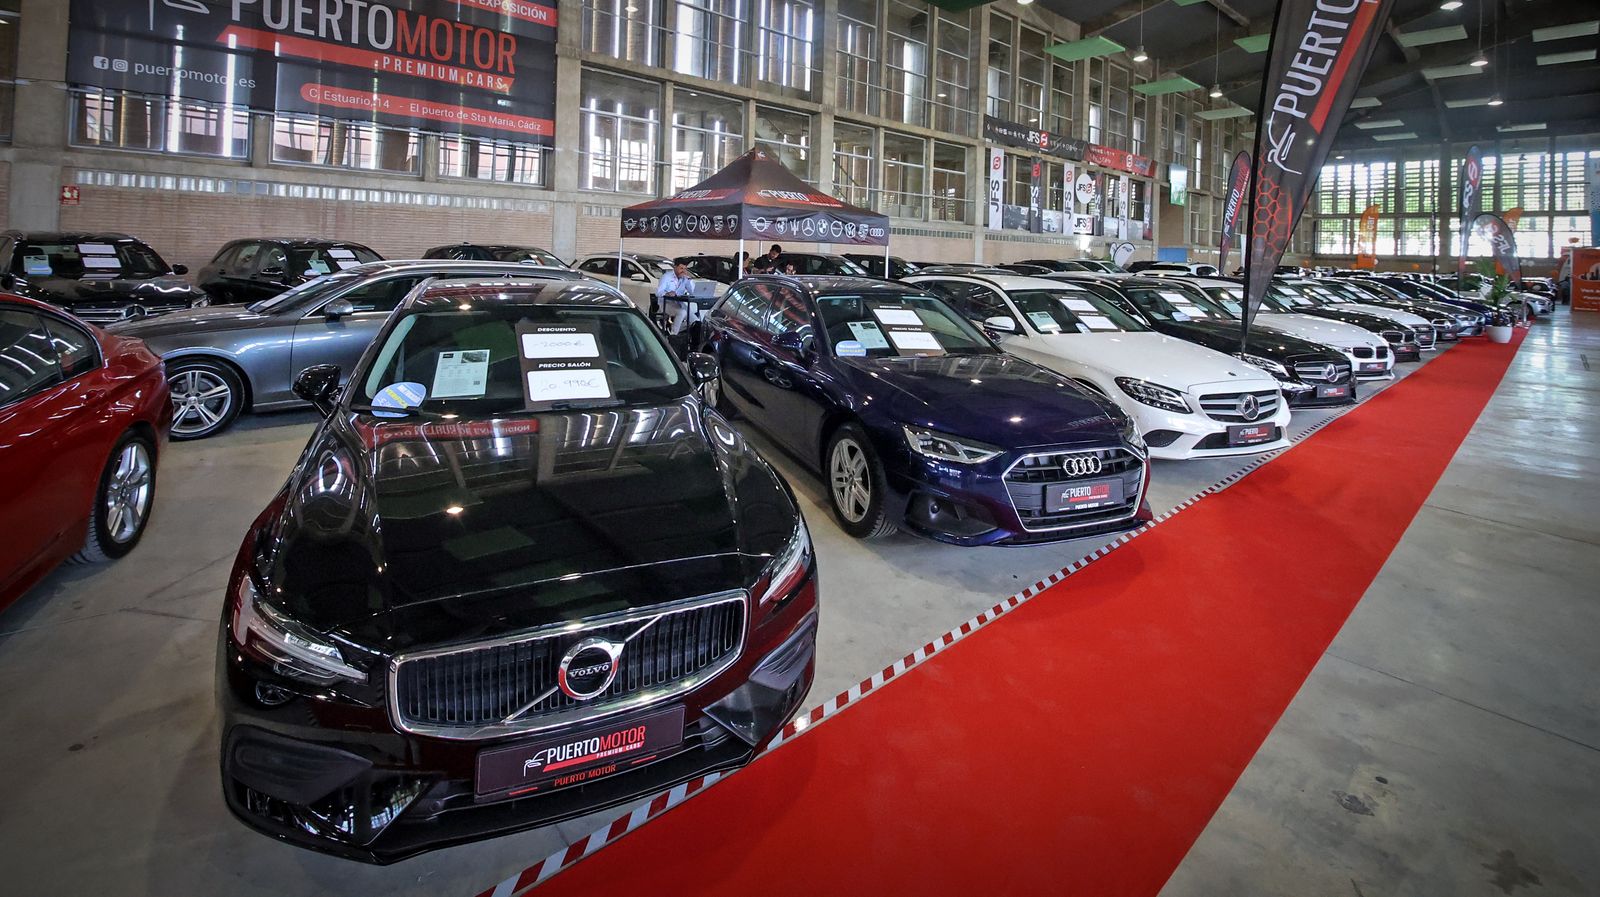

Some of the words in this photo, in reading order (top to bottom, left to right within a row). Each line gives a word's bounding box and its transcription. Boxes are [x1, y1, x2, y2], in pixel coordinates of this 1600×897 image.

[134, 61, 256, 88] pueromoto.es
[383, 56, 458, 83] PREMIUM
[466, 73, 503, 90] CARS
[324, 90, 373, 107] Estuario,
[376, 97, 390, 108] 14
[410, 103, 419, 113] El
[422, 105, 454, 118] puerto
[456, 110, 468, 119] de
[471, 112, 486, 123] Sta
[517, 119, 542, 131] Cádiz
[1027, 131, 1040, 144] JFS
[991, 180, 1000, 213] JFS
[1030, 186, 1039, 217] JFS
[1077, 184, 1087, 192] JFS
[1064, 191, 1072, 220] JFS
[1075, 218, 1087, 228] JFS
[569, 664, 610, 678] VOLVO
[546, 725, 646, 764] PUERTOMOTOR
[596, 746, 623, 759] PREMIUM
[554, 772, 585, 787] PUERTO
[588, 764, 617, 779] MOTOR
